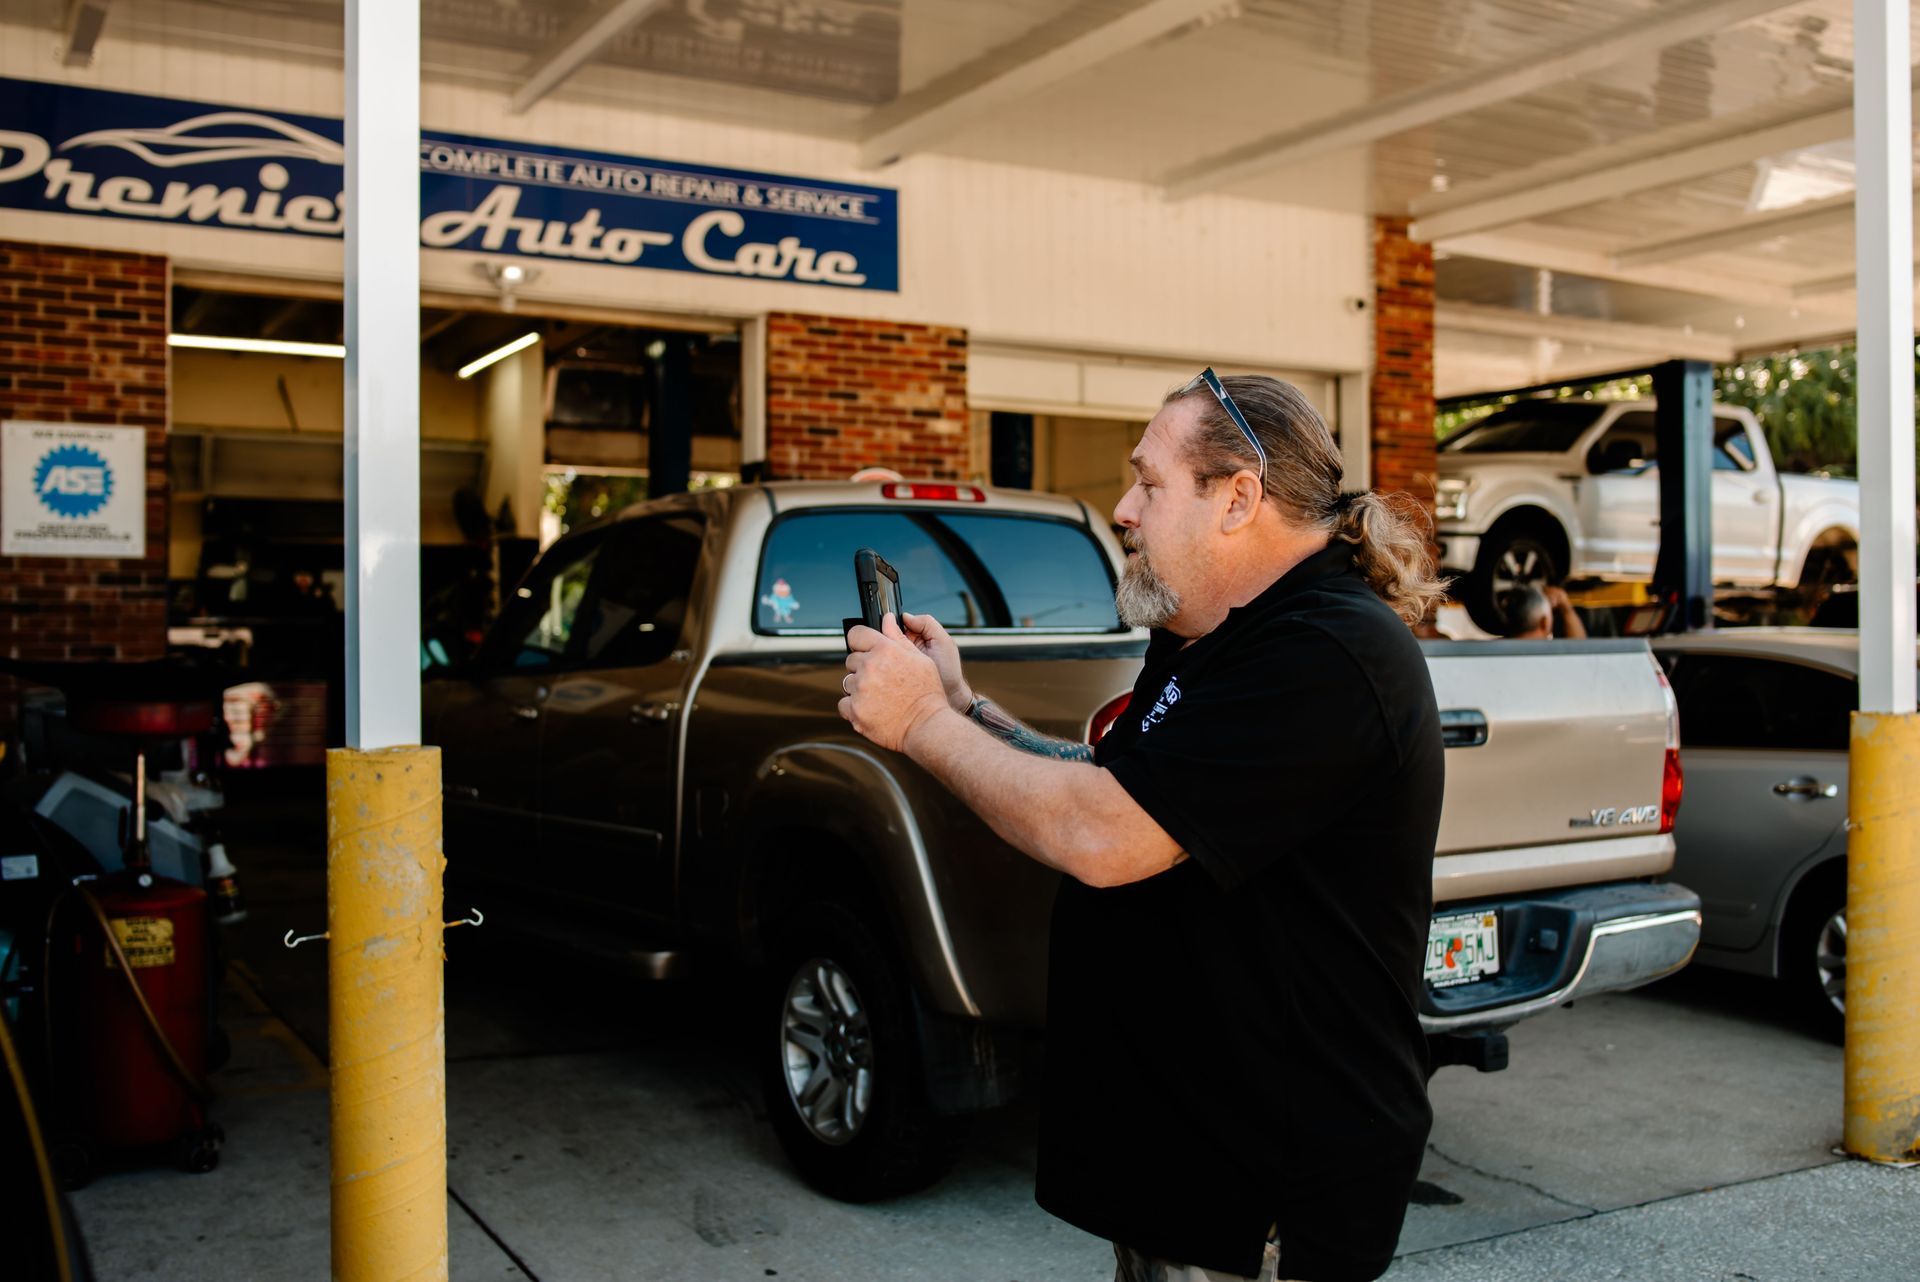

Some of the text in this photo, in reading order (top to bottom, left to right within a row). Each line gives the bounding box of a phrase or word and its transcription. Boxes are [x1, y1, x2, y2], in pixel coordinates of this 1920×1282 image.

[0, 129, 866, 286] Premie Auto Care
[420, 144, 865, 219] COMPLETE AUTO REPAIR & SERVICE
[40, 465, 105, 496] ASE
[1619, 804, 1659, 825] AWD
